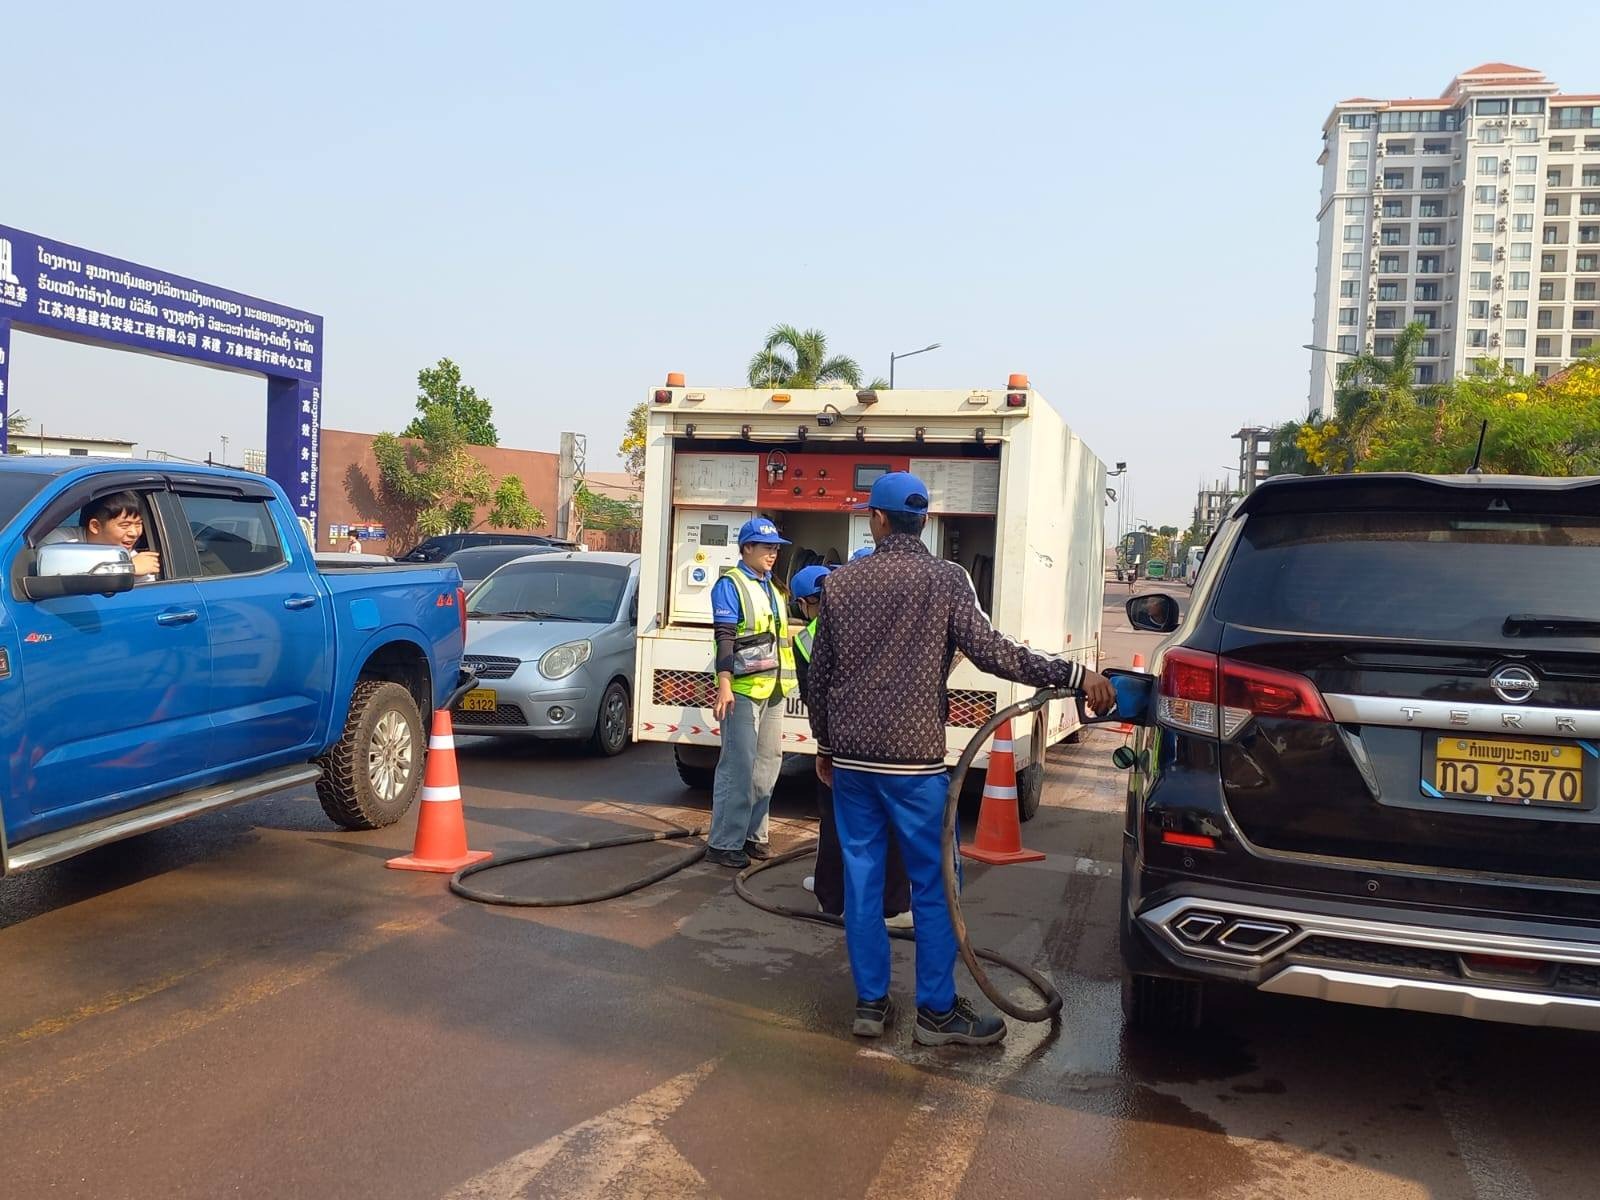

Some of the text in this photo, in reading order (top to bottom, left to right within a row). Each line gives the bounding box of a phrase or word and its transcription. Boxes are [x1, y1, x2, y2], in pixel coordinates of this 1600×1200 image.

[38, 245, 81, 273] ໂຄງການ
[38, 297, 197, 348] 江苏鸿基建筑安装工程有限公司
[201, 335, 221, 353] 承建
[1496, 679, 1537, 691] NISSAN
[469, 699, 494, 711] 3122
[1469, 742, 1549, 763] ກຳແພງນະຄອນ
[1440, 761, 1578, 802] ກວ 3570
